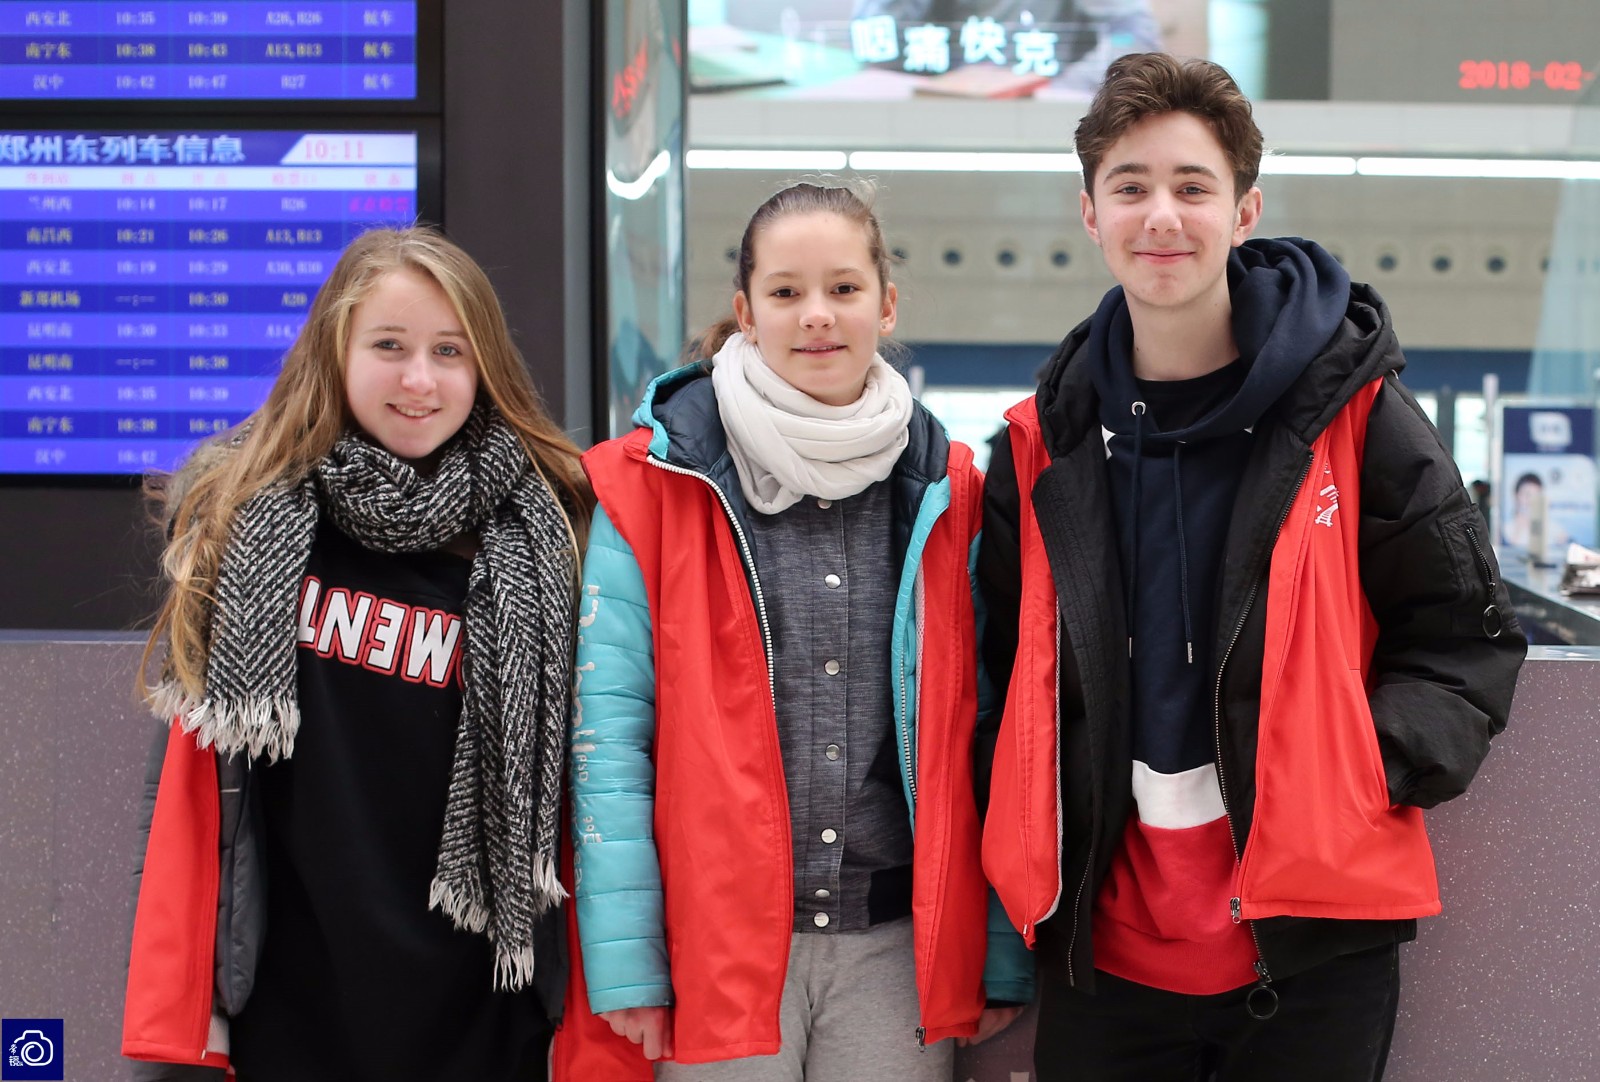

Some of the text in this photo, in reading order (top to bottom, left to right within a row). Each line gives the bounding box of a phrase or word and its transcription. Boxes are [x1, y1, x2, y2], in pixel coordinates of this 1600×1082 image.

[0, 134, 246, 164] 郑州东列车信息
[304, 139, 364, 161] 10:11
[297, 575, 465, 690] MENT
